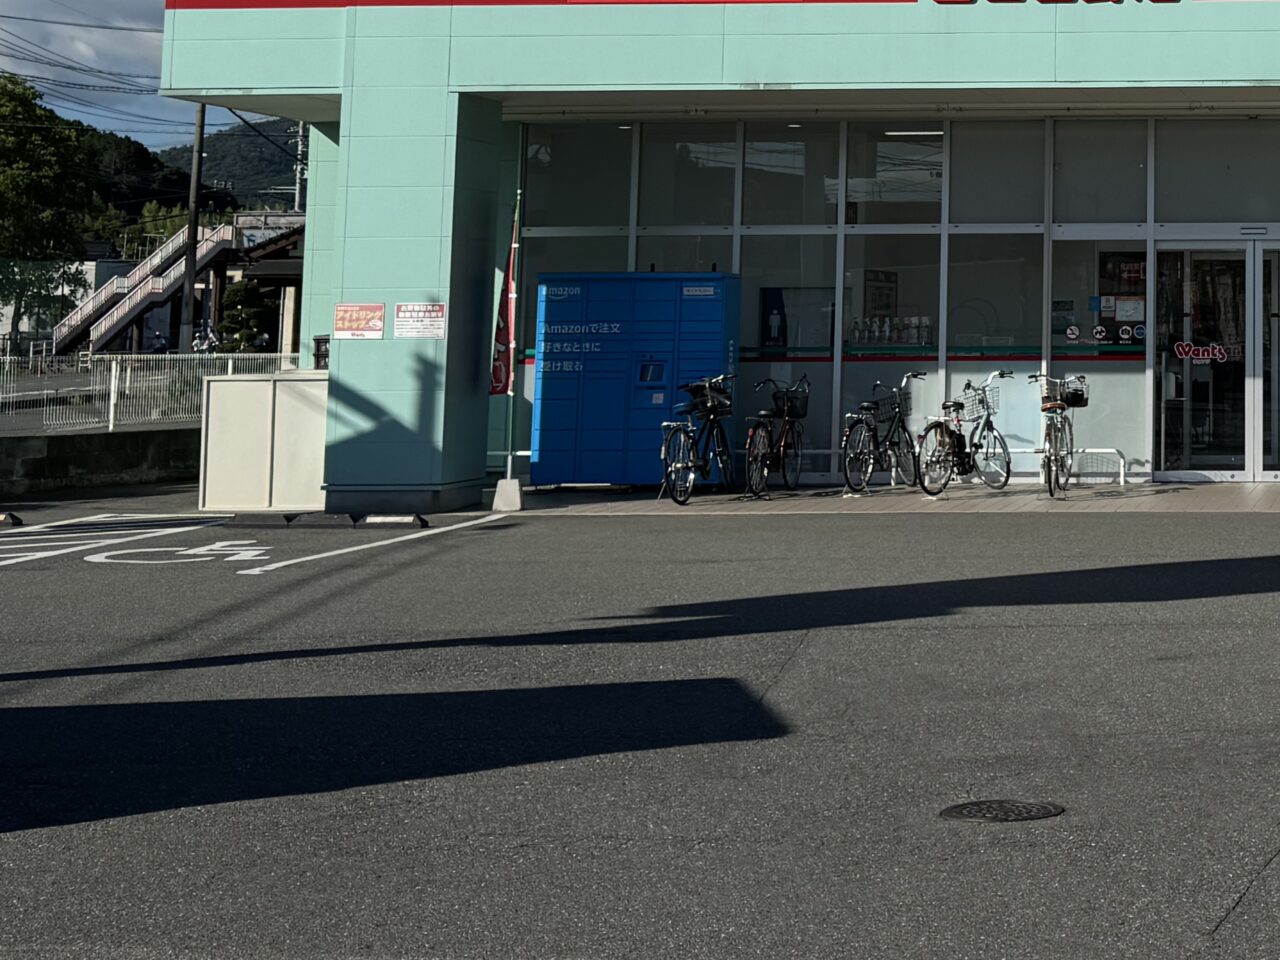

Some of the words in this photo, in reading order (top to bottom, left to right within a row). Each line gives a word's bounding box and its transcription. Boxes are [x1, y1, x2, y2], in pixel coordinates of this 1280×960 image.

[335, 310, 383, 320] アイドリング
[542, 322, 621, 334] Amazonで注文
[1174, 342, 1227, 363] Wants
